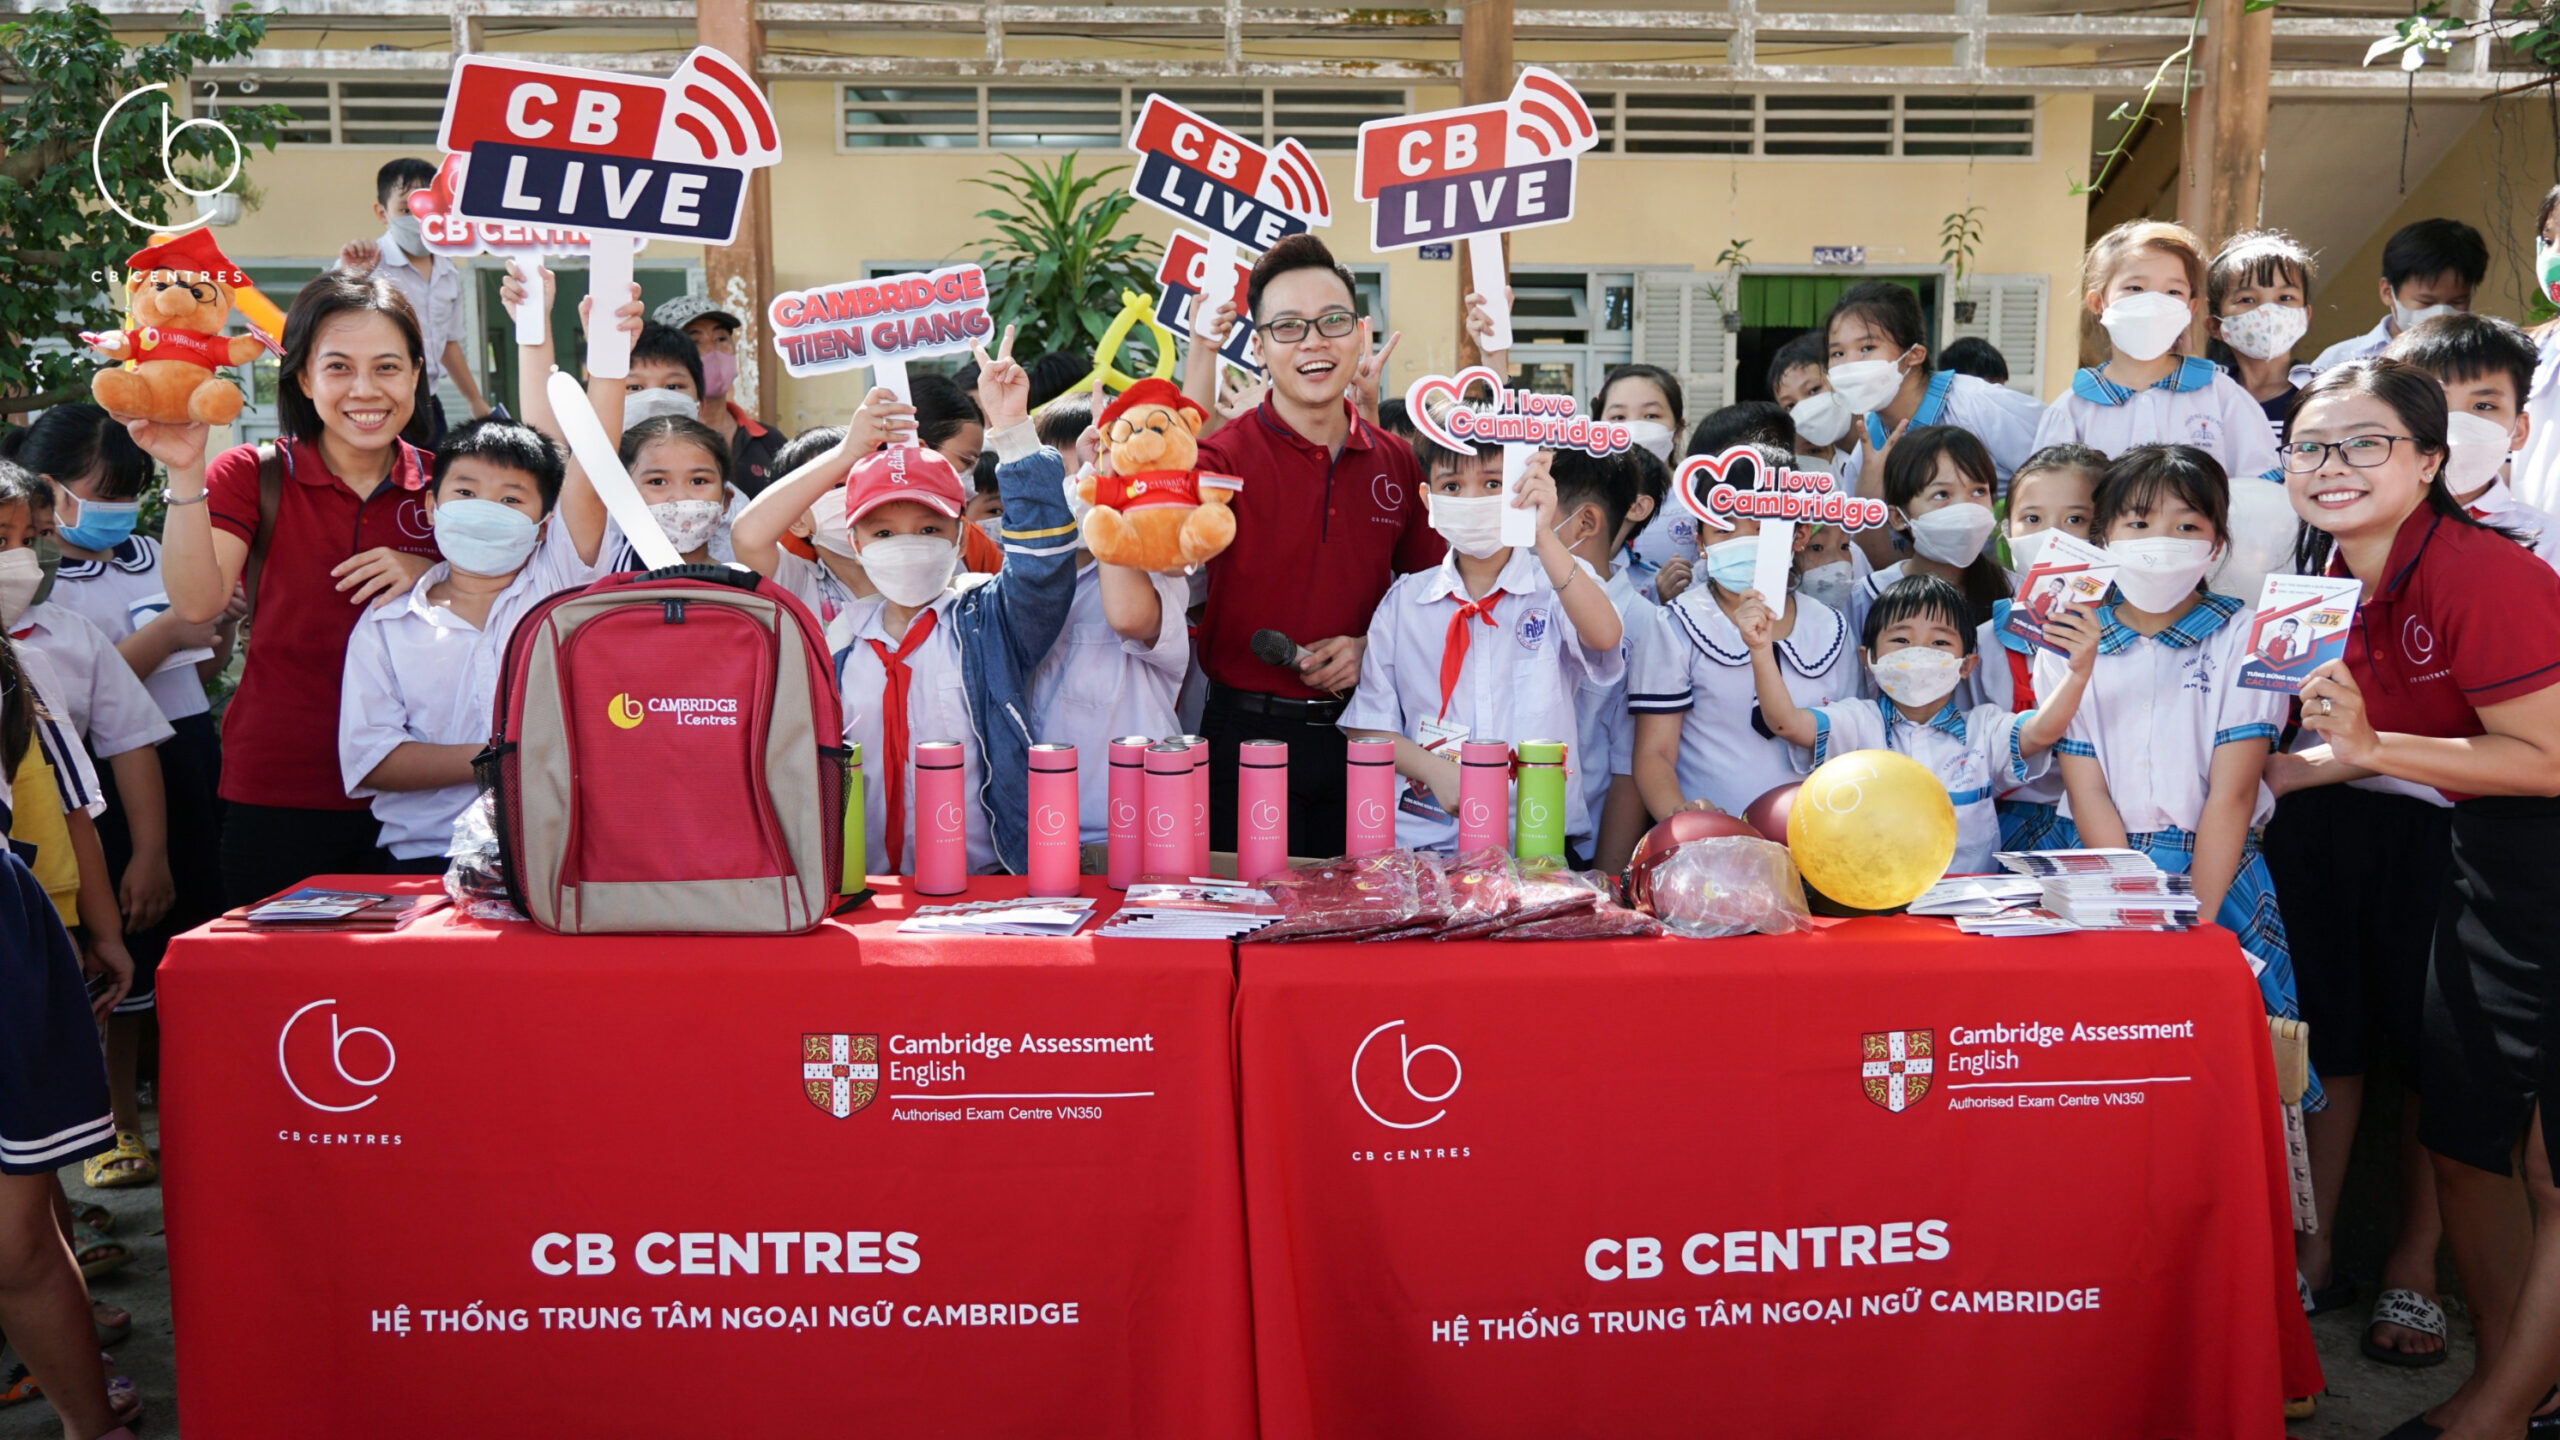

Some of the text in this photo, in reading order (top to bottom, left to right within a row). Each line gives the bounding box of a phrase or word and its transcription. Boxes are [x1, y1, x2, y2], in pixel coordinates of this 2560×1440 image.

[506, 82, 622, 146] CB
[1171, 123, 1241, 179] CB
[1398, 123, 1478, 177] CB
[502, 156, 708, 227] LIVE
[1404, 170, 1547, 235] LIVE
[1161, 165, 1287, 250] LIVE
[421, 214, 468, 242] CB
[773, 268, 985, 328] CAMBRIDGE
[779, 307, 990, 366] TIEN GIANG
[1505, 392, 1577, 416] I love
[1449, 411, 1630, 452] Cambridge
[1764, 468, 1833, 493] I love
[1710, 487, 1886, 530] Cambridge
[2310, 612, 2340, 626] 20%
[648, 698, 738, 721] CAMBRIDGE
[684, 713, 737, 725] Centres
[890, 1032, 1154, 1058] Cambridge Assessment
[1949, 1019, 2194, 1048] Cambridge Assessment
[890, 1060, 966, 1083] English
[1948, 1049, 2019, 1075] English
[892, 1106, 1102, 1121] Authorised Exam Centre VN350
[1948, 1092, 2145, 1110] Authorised Exam Centre VN350
[279, 1130, 402, 1145] CB CENTRES
[1353, 1147, 1471, 1162] CB CENTRES
[532, 1232, 921, 1276] CB CENTRES
[1585, 1220, 1950, 1282] CB CENTRES
[373, 1300, 1079, 1337] HỆ THỐNG TRUNG TÂM NGOẠI NGỮ CAMBRIDGE
[1433, 1287, 2100, 1347] HỆ THỐNG TRUNG TÂM NGOẠI NGỮ CAMBRIDGE
[2391, 1300, 2430, 1319] NIKIE
